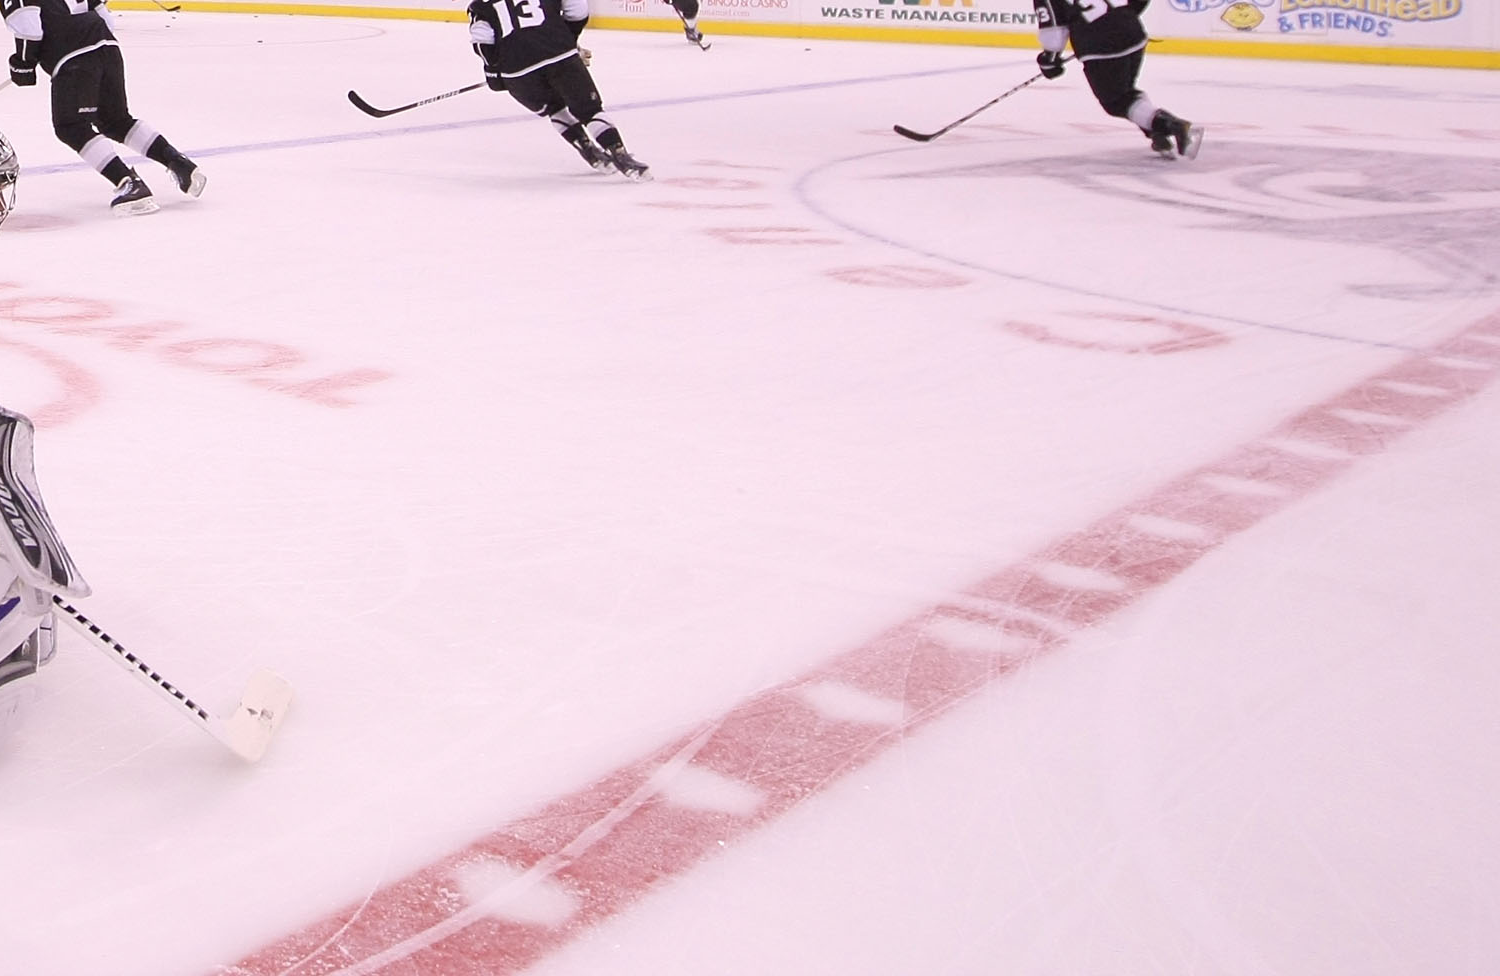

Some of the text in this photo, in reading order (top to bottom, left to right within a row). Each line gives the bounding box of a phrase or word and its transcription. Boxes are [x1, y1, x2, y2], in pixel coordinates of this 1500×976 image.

[821, 6, 1036, 25] WASTE MANAGEMENT
[1298, 11, 1394, 37] FRIENDS
